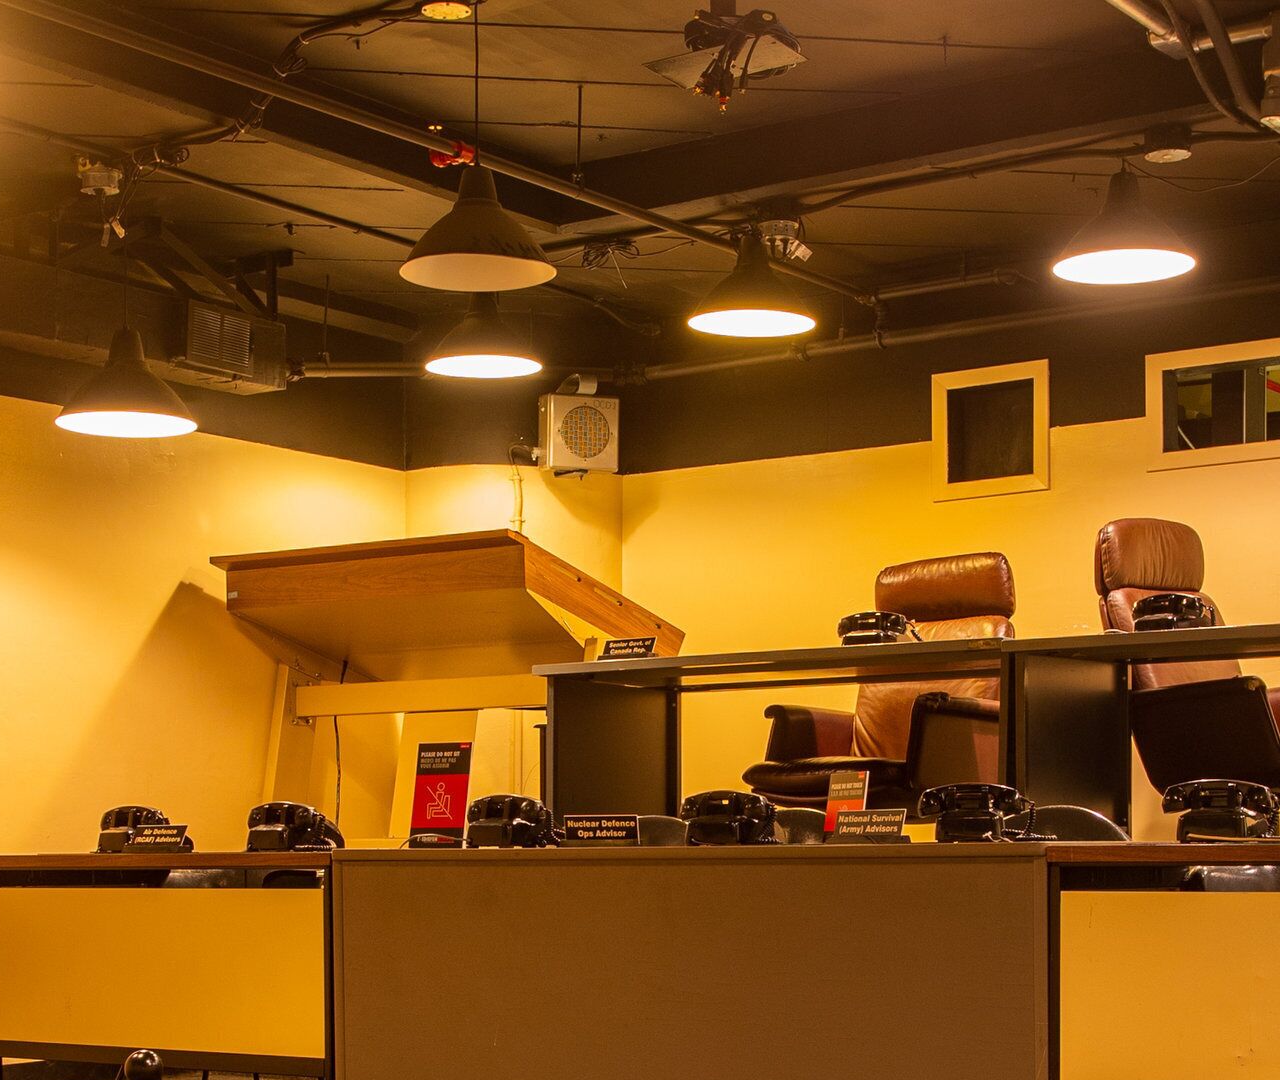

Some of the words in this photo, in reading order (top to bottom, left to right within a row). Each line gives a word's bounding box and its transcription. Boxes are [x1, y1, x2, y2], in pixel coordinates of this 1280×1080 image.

[839, 815, 870, 823] National
[871, 814, 903, 822] Survival
[839, 825, 864, 834] (Army)
[865, 825, 898, 833] Advisors
[578, 830, 594, 839] Ops
